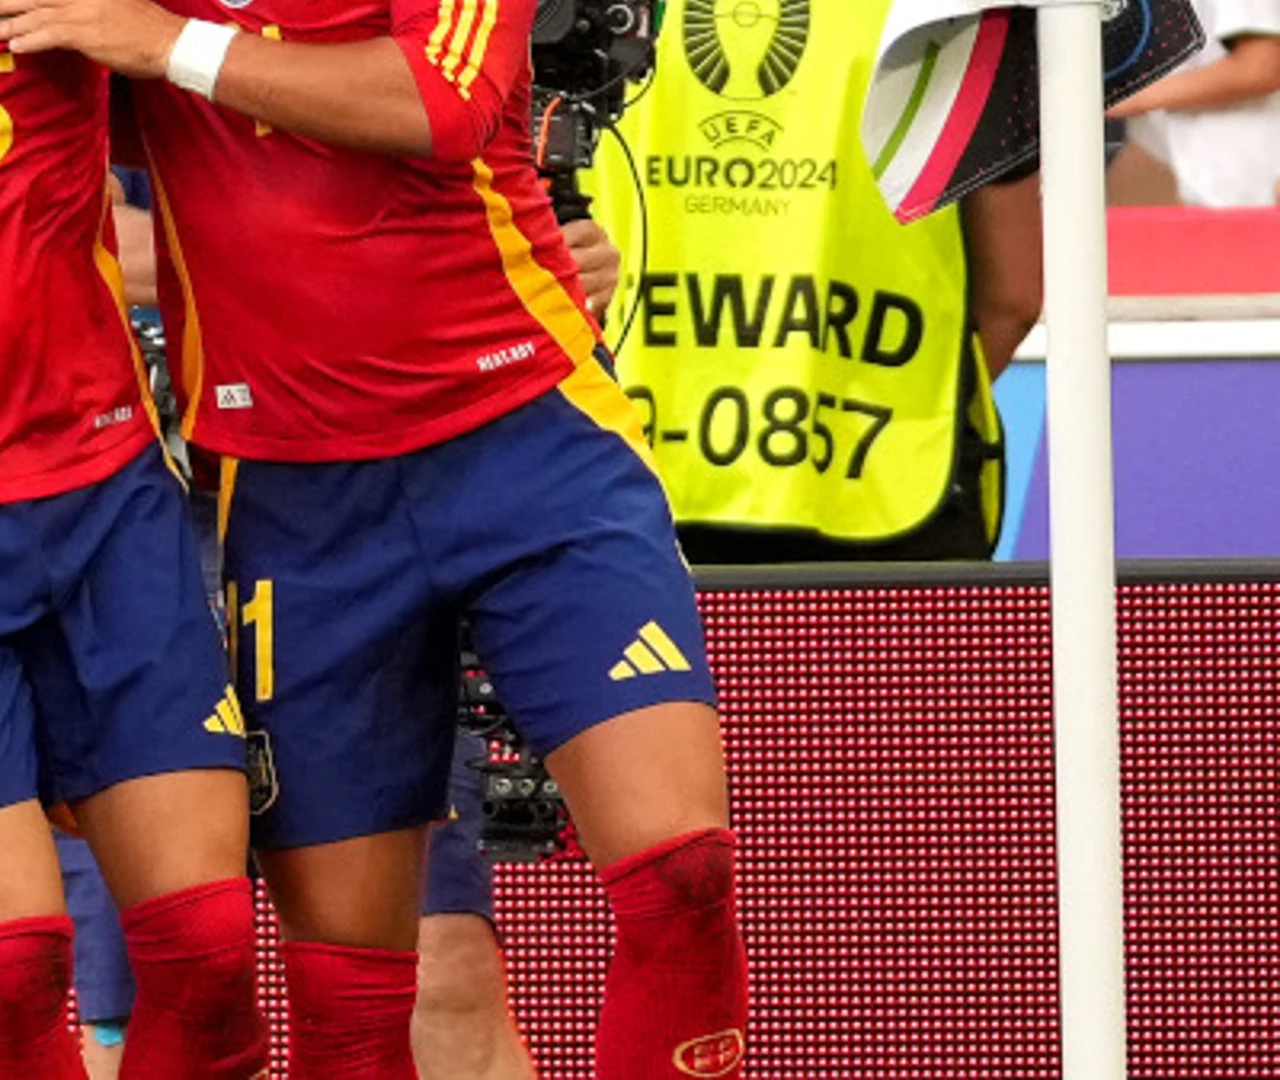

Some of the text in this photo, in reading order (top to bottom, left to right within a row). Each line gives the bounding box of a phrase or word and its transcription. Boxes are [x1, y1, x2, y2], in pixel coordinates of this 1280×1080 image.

[702, 116, 775, 146] UEFA
[646, 155, 837, 190] EURO2024
[684, 195, 790, 217] GERMANY
